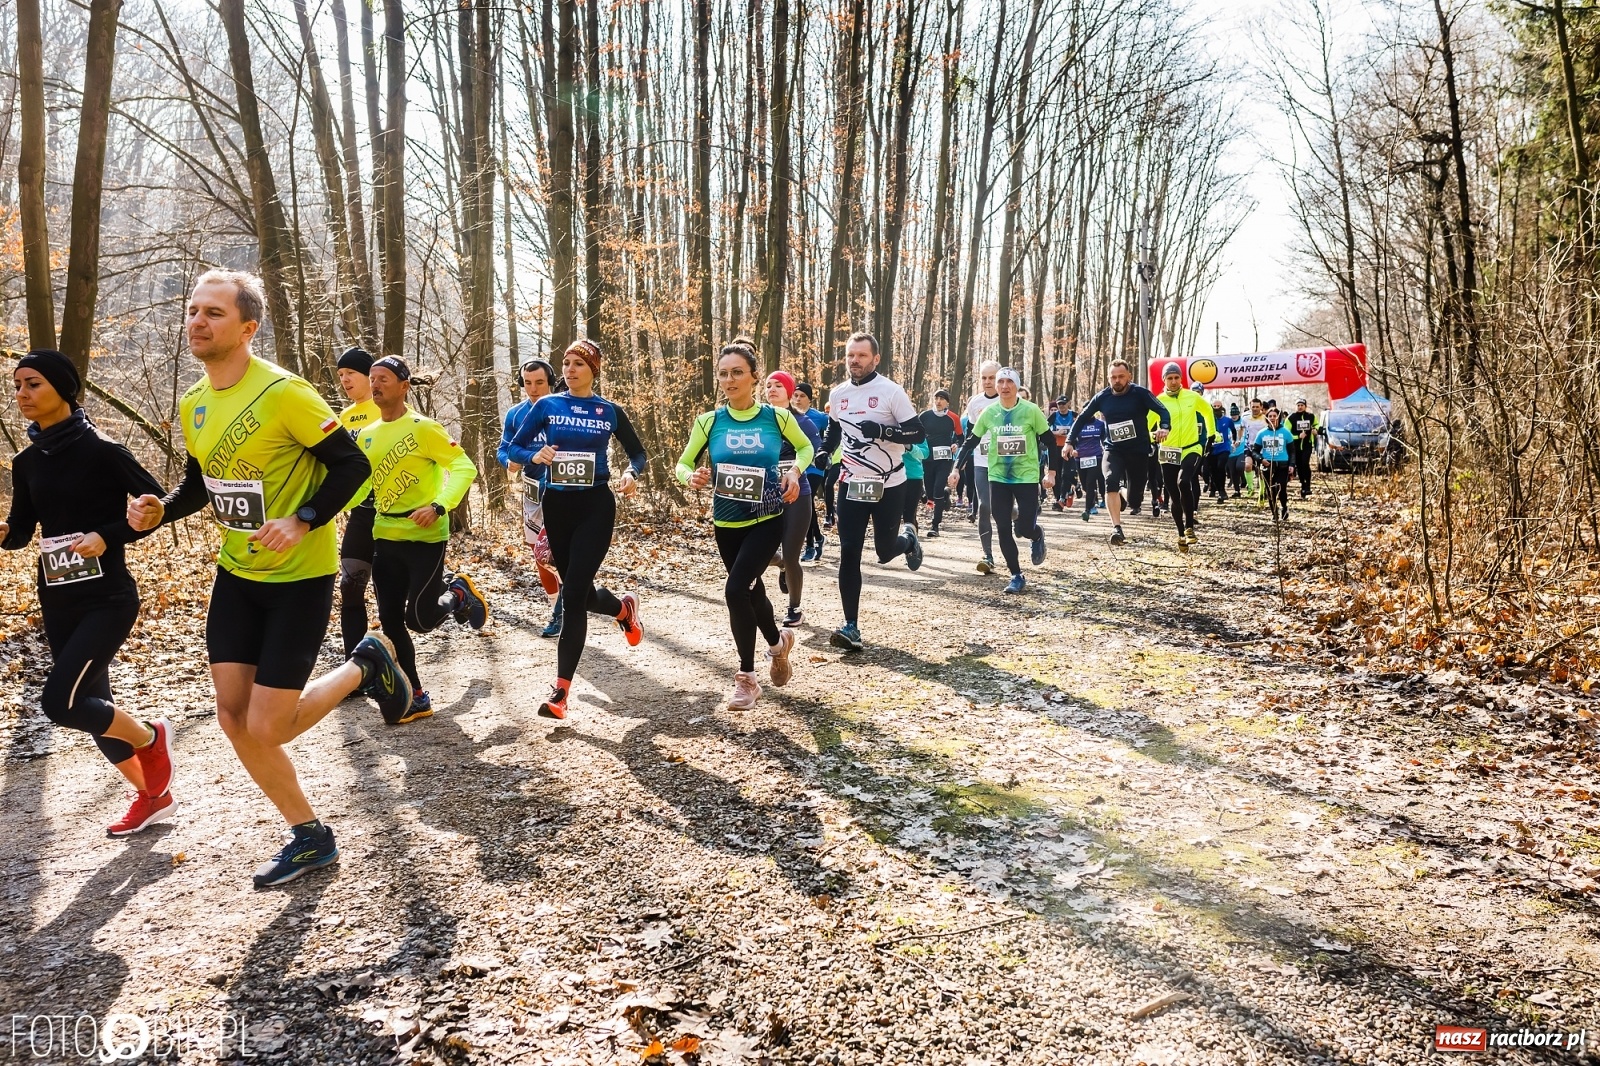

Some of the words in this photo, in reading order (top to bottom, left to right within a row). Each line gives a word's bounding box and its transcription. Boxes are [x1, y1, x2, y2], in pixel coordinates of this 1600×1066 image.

[1224, 363, 1288, 374] TWARDZIELA
[1230, 373, 1281, 383] RACIBÓRZ
[548, 415, 612, 431] RUNNERS
[993, 423, 1023, 435] synthos
[1114, 427, 1130, 436] 039
[1002, 442, 1021, 450] 027
[1164, 451, 1177, 460] 102
[558, 462, 586, 476] 068
[725, 475, 754, 492] 092
[857, 483, 874, 495] 114
[214, 494, 250, 517] 079
[48, 551, 85, 571] 044
